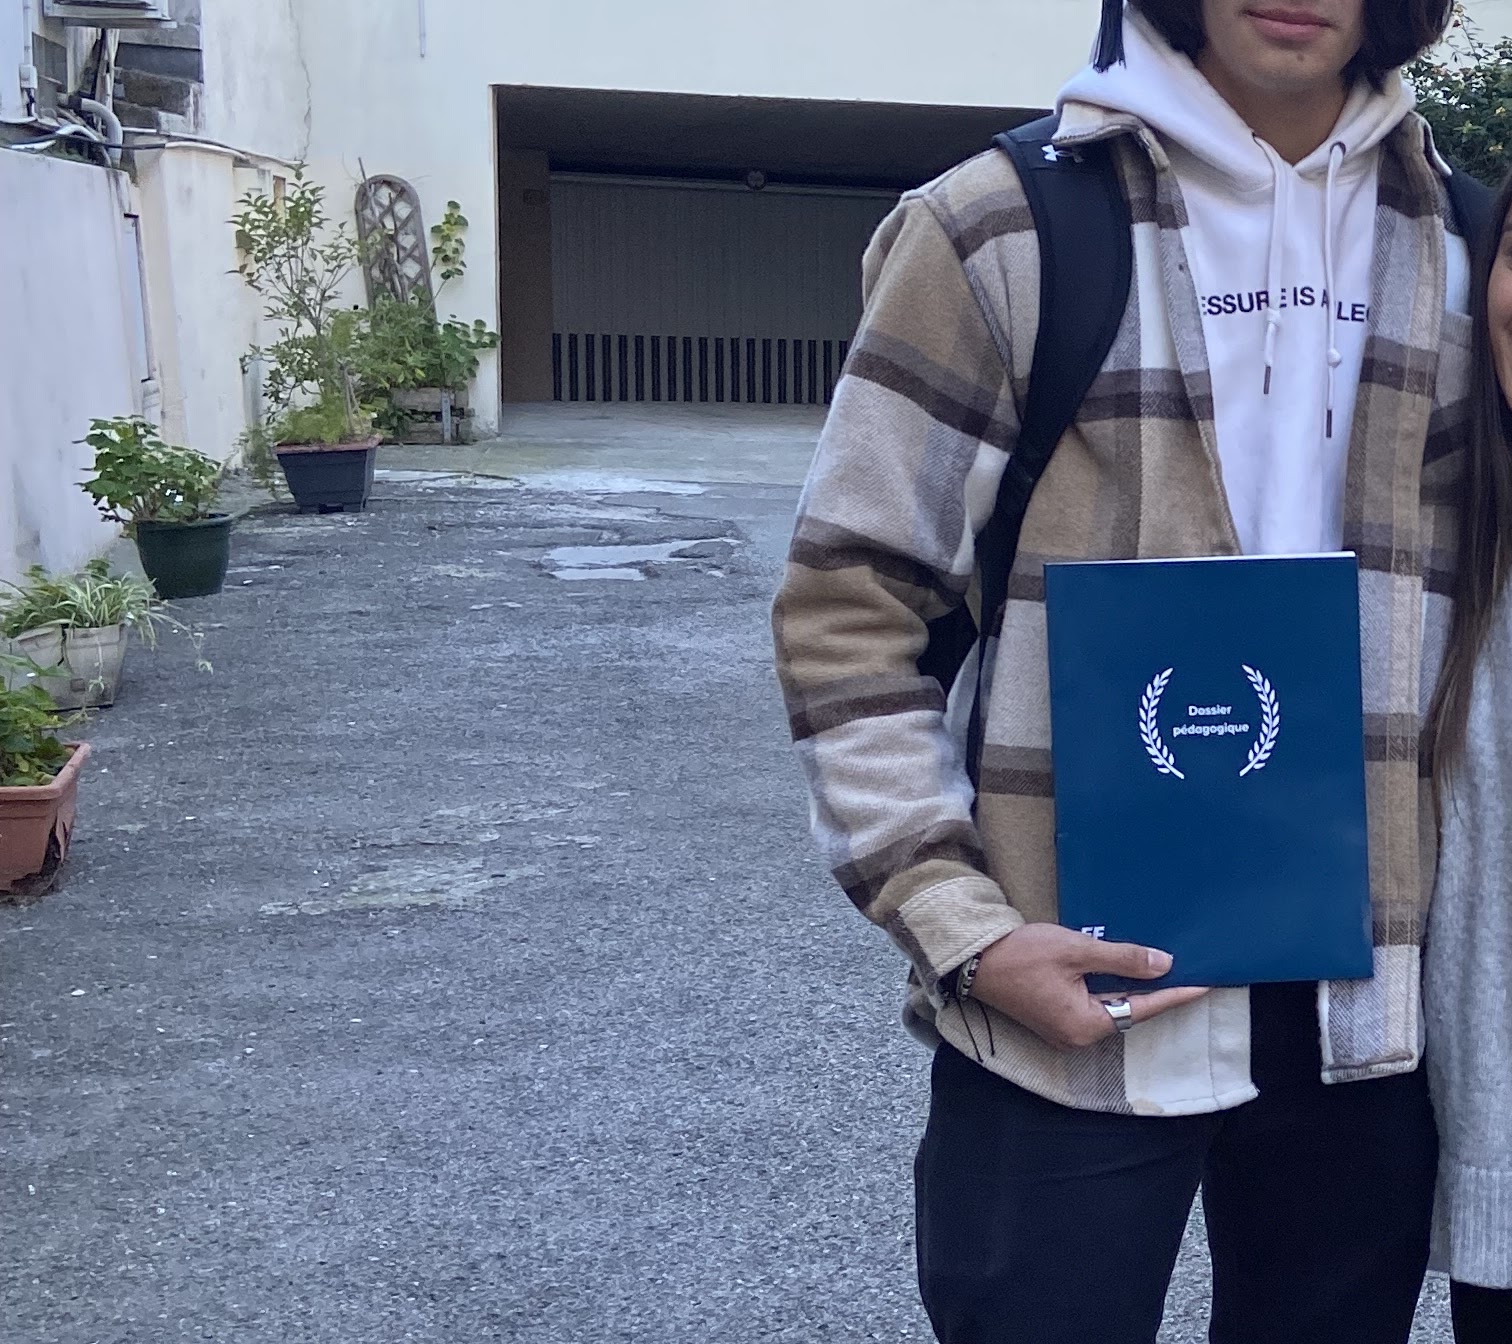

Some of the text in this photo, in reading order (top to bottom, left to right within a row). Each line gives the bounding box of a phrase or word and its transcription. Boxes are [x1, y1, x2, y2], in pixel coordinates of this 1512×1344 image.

[1293, 286, 1316, 306] IS
[1336, 301, 1371, 323] LE
[1188, 703, 1232, 716] Dossier
[1172, 721, 1250, 738] pédagogique
